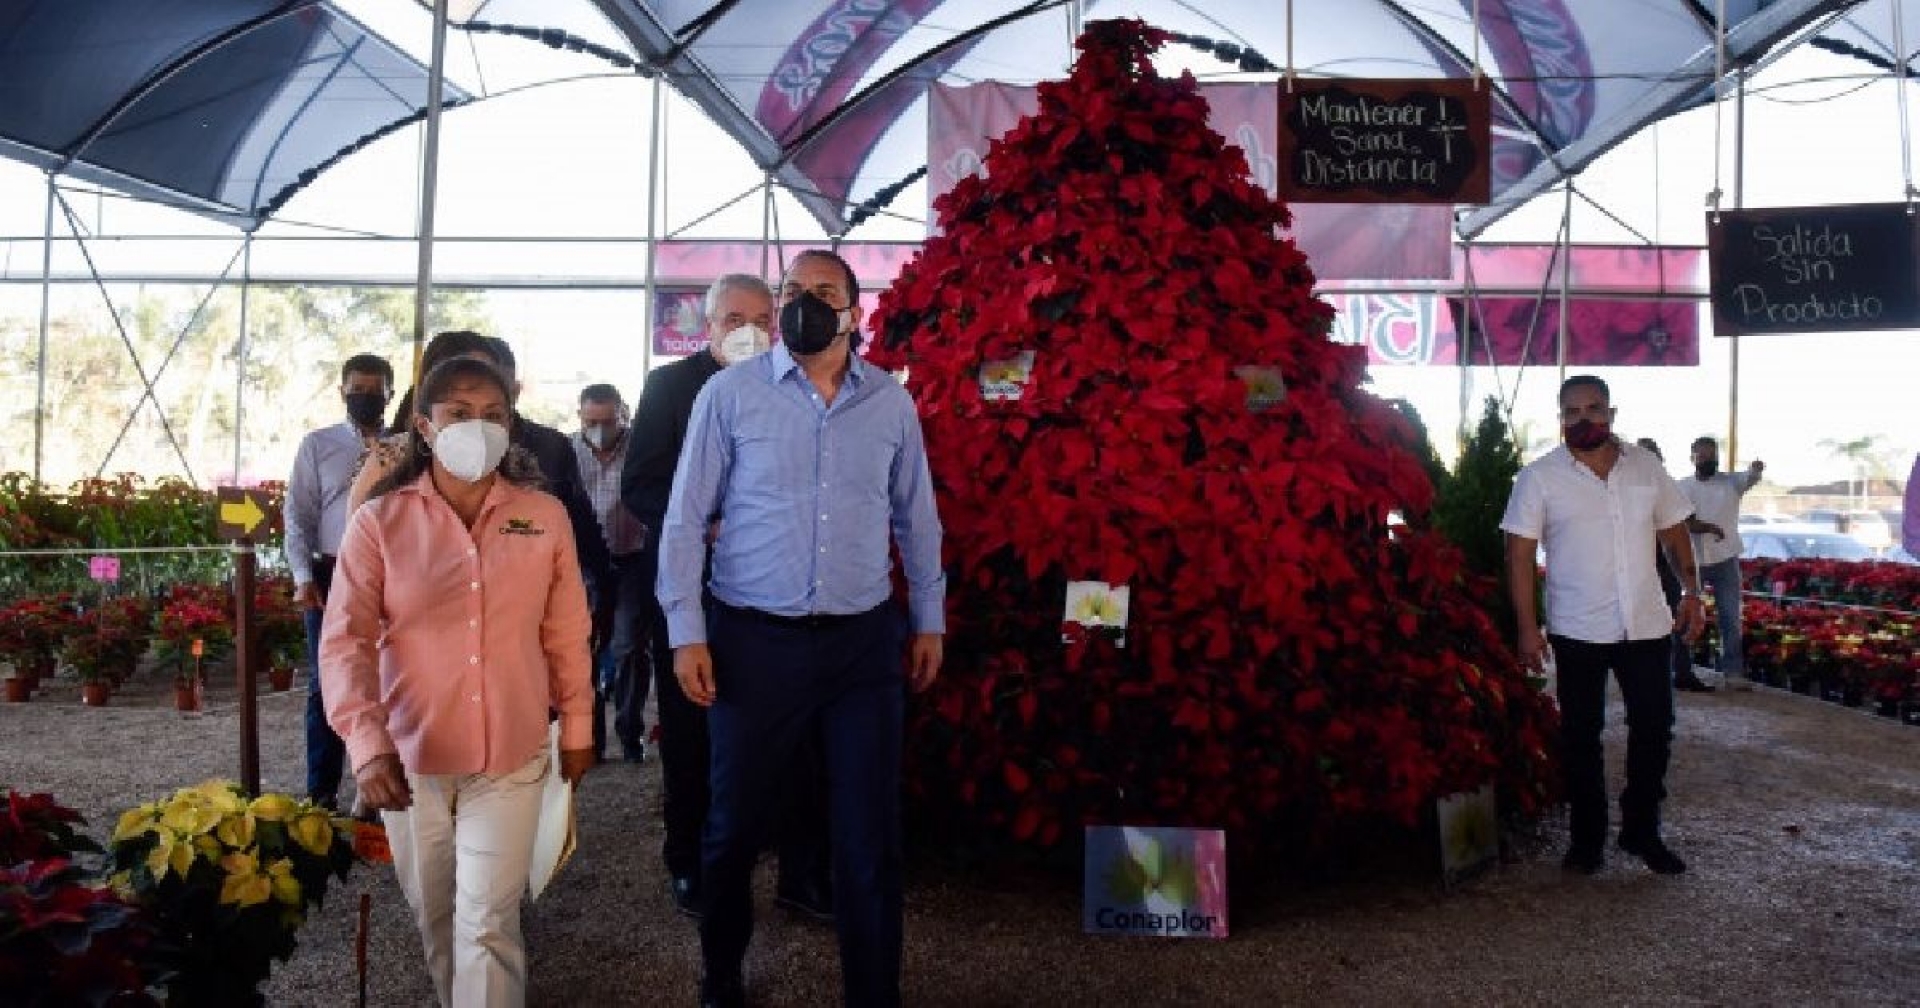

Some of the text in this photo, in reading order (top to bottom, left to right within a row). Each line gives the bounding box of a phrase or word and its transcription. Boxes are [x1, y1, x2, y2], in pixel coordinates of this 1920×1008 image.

[1301, 96, 1427, 126] Mantener
[1304, 149, 1436, 184] Distancia
[1753, 224, 1853, 261] Salida
[1733, 284, 1882, 322] Producto
[1096, 908, 1217, 935] Conaplor
